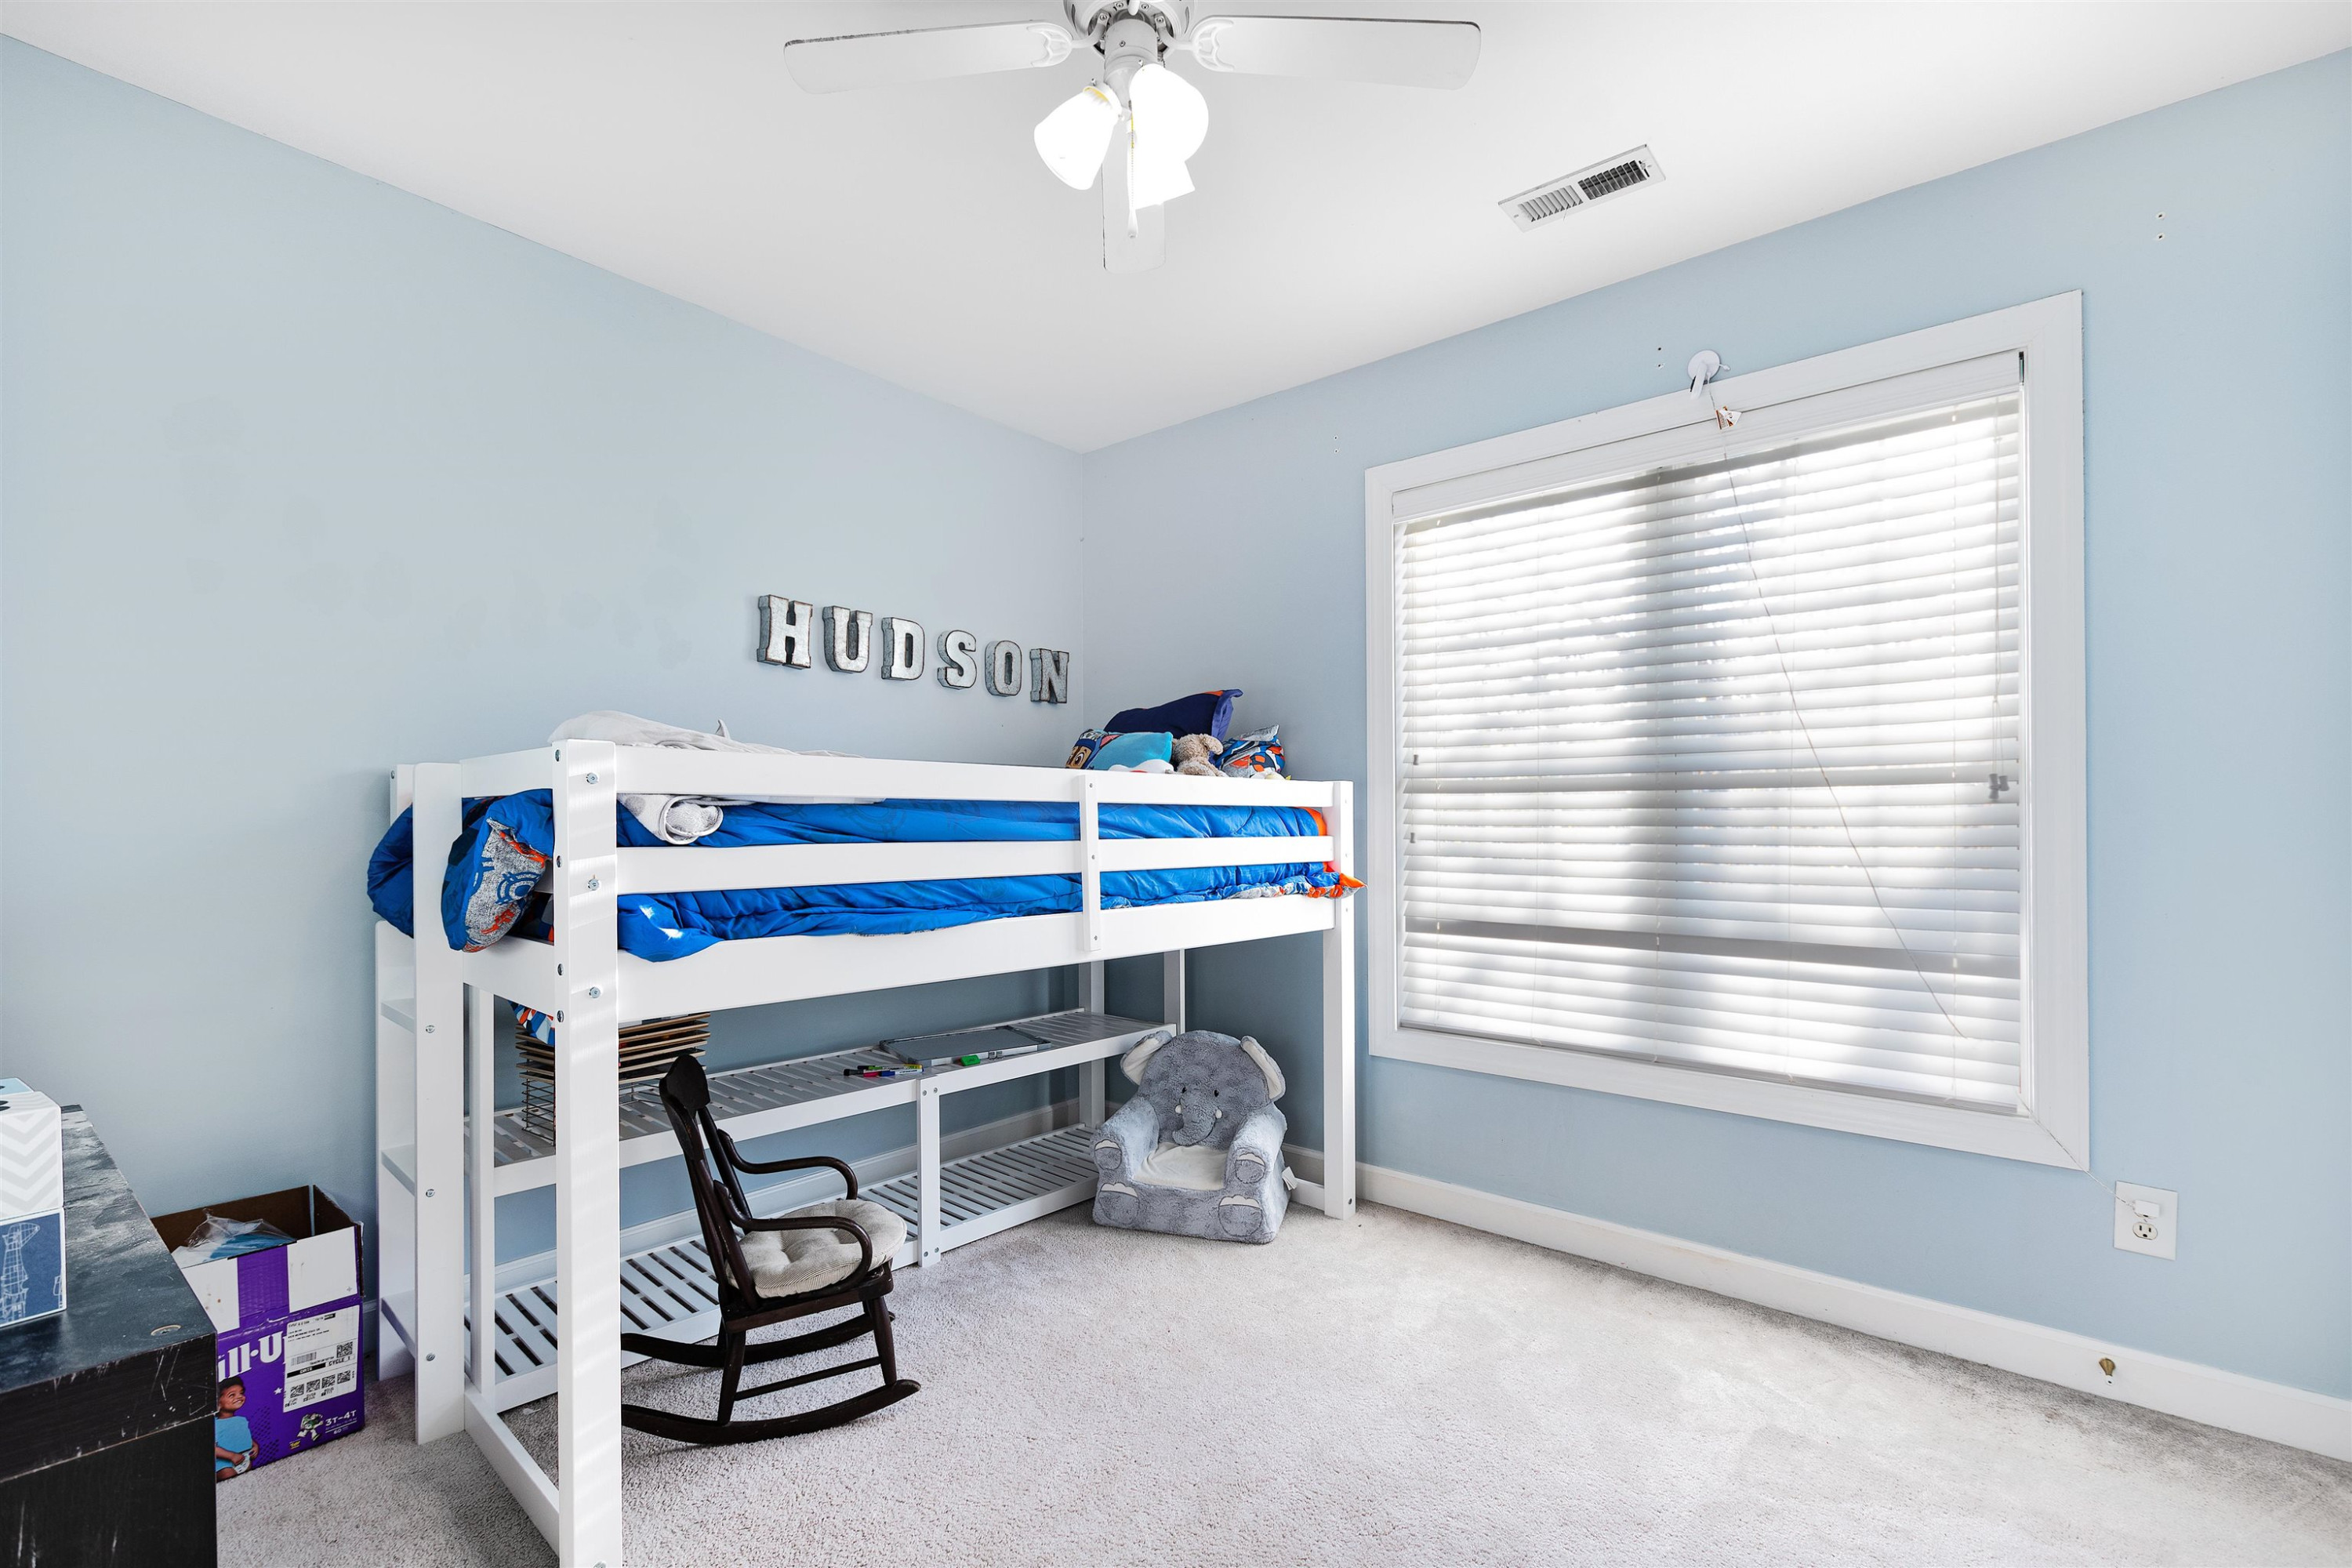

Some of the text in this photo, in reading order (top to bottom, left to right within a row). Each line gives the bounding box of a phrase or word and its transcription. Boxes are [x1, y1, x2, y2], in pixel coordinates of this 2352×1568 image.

[757, 594, 1069, 704] HUDSON
[328, 1357, 345, 1367] CYCLE
[325, 1410, 357, 1426] 3T-4T
